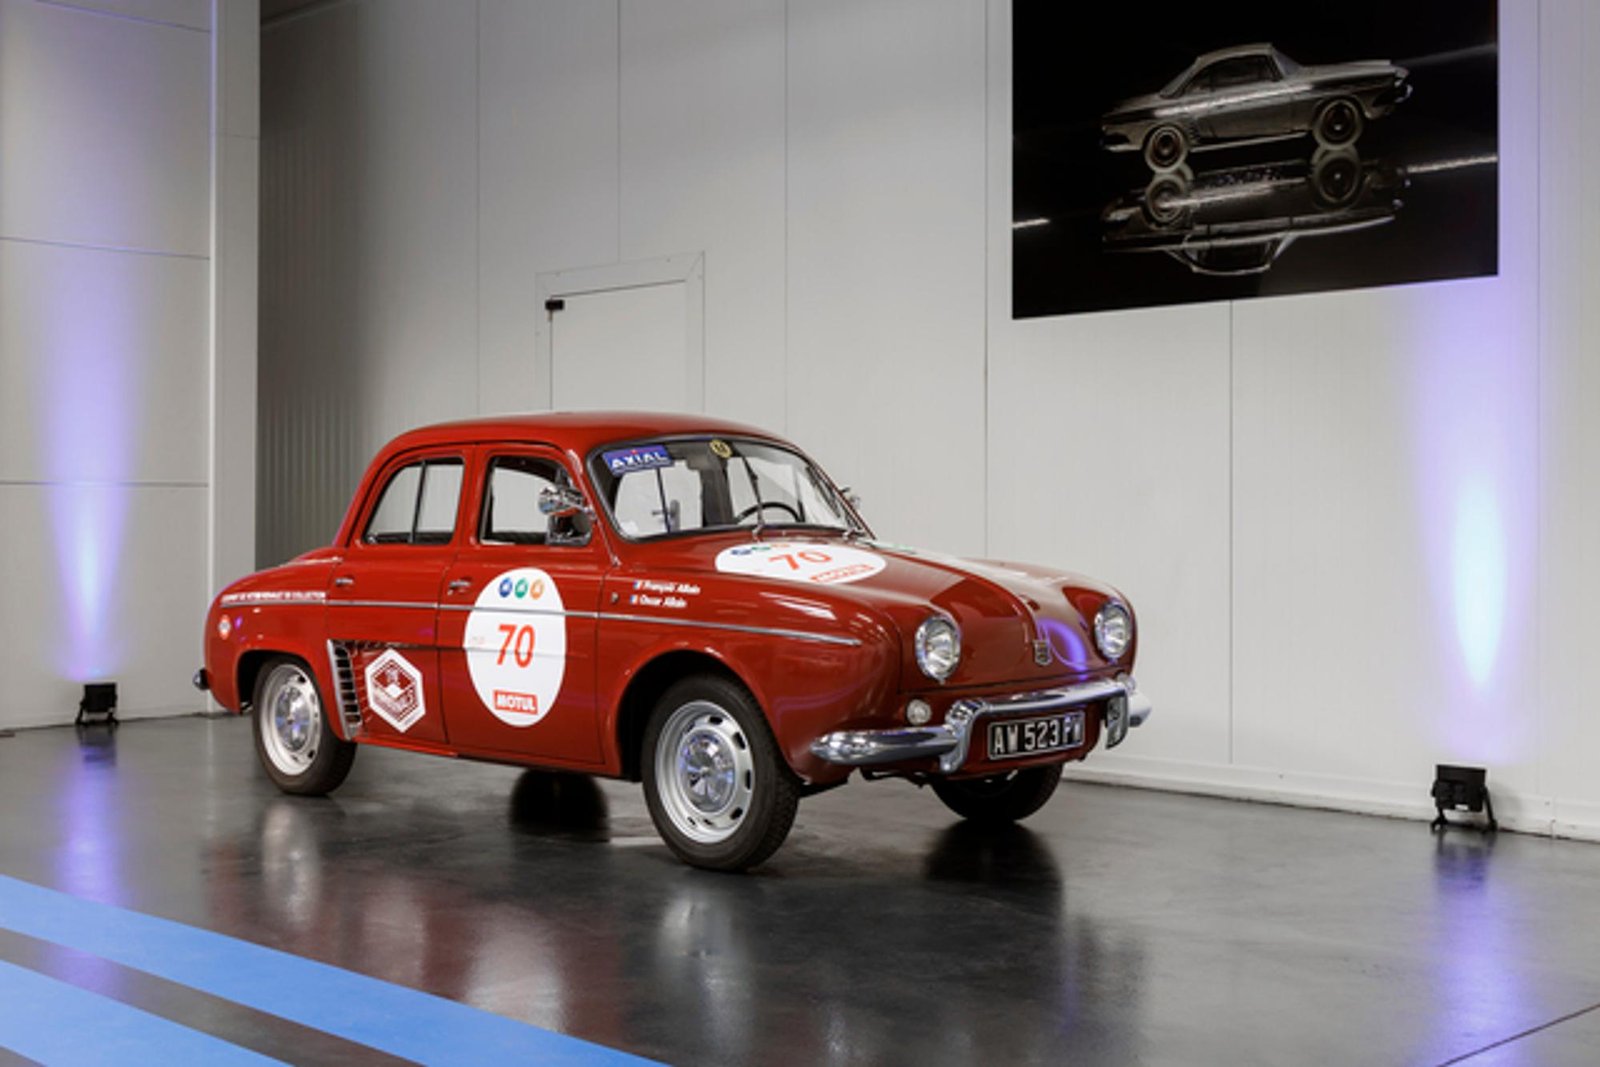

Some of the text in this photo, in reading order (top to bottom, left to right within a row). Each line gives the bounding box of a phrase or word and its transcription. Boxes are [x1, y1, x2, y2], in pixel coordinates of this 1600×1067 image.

[612, 451, 668, 468] AXIAL
[769, 550, 832, 571] 70
[497, 623, 536, 668] 70
[496, 693, 537, 711] MOTUL
[1024, 719, 1060, 751] 523
